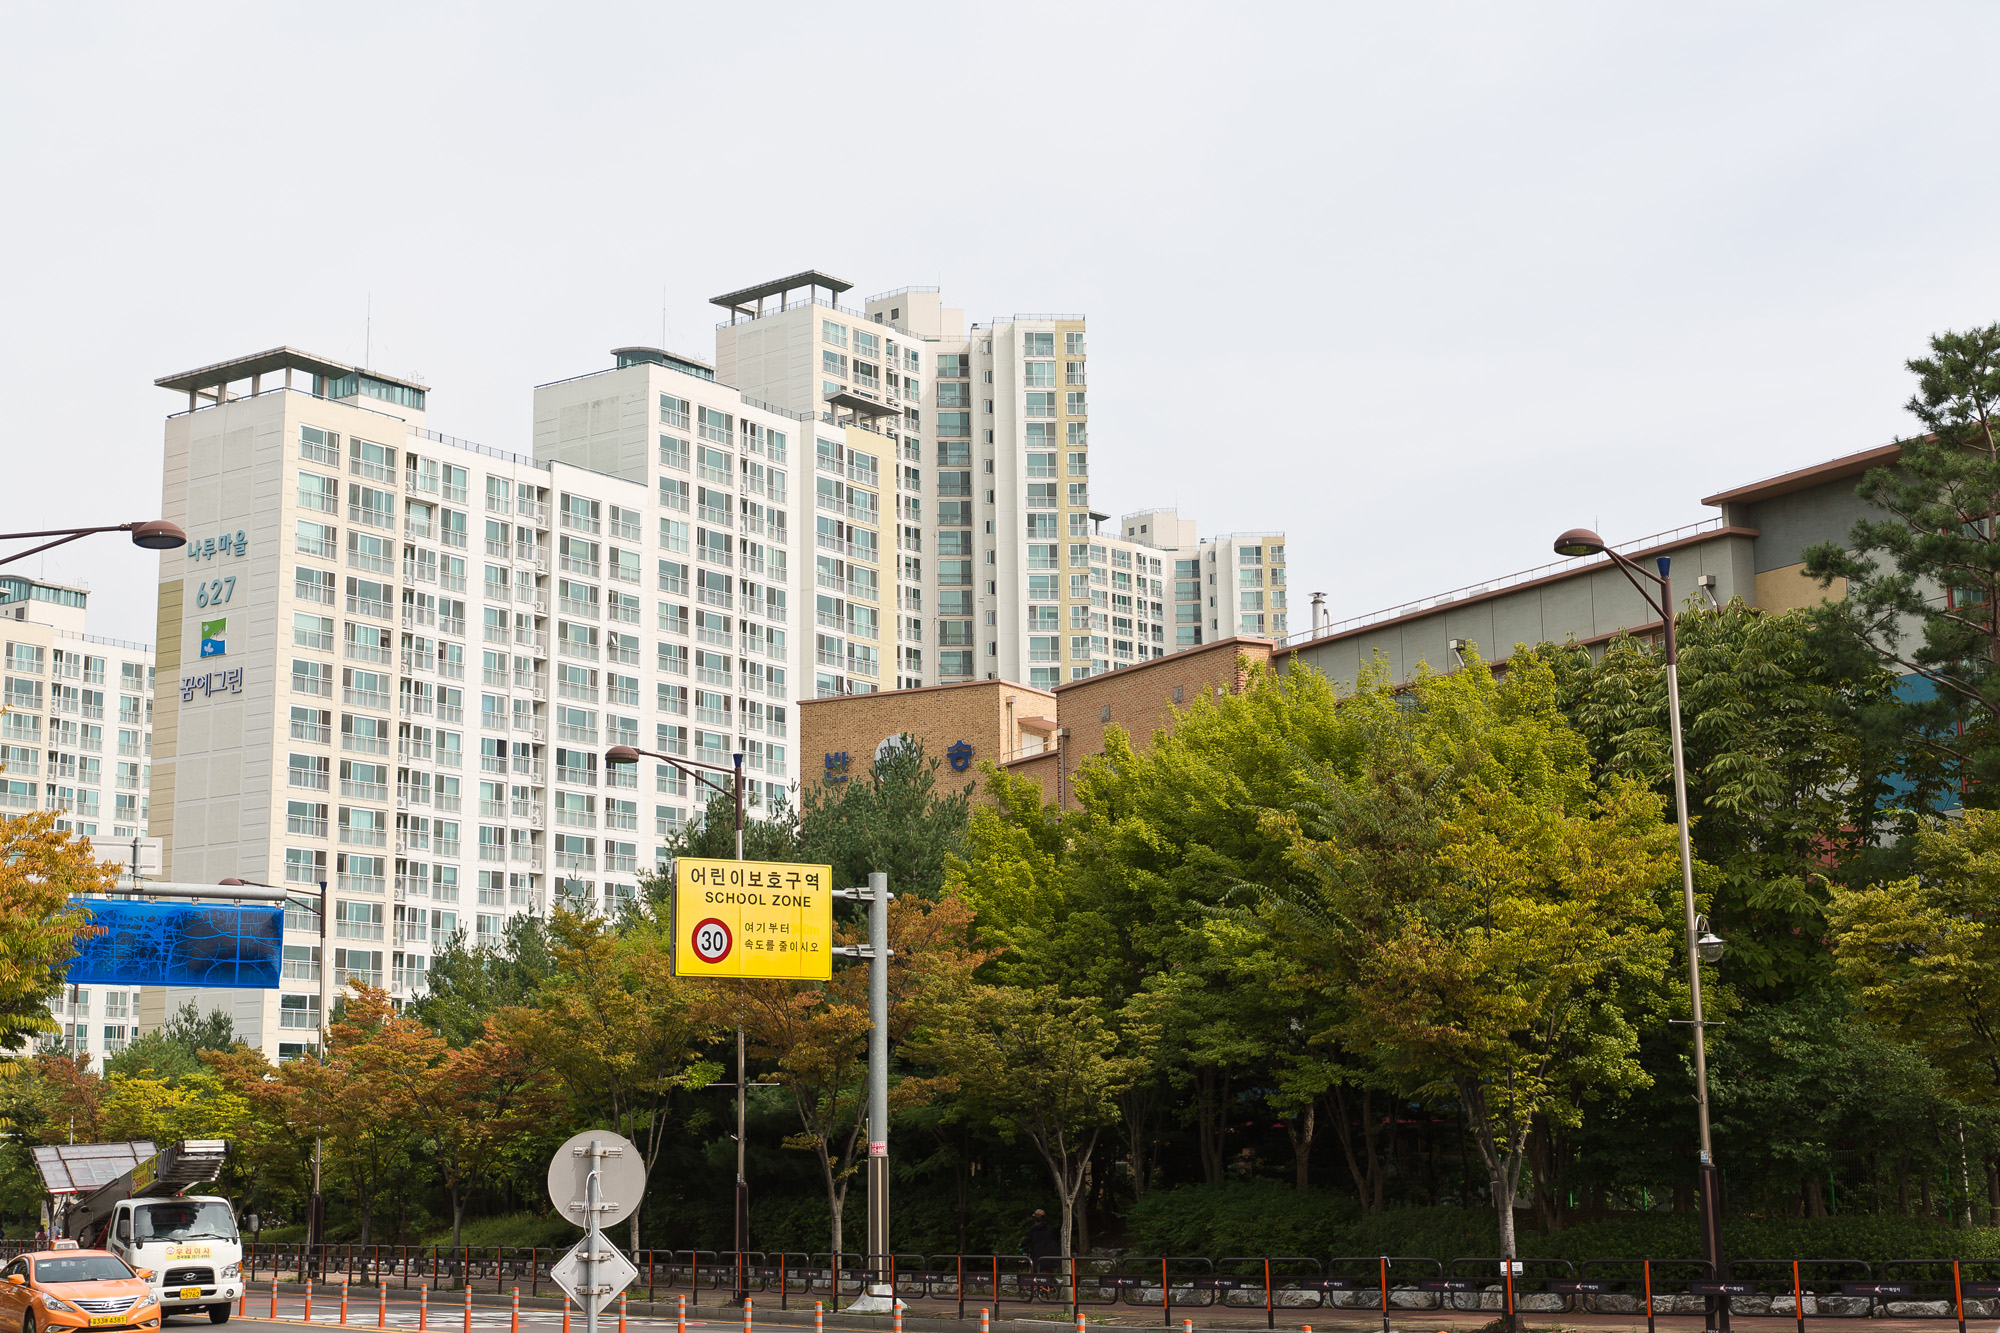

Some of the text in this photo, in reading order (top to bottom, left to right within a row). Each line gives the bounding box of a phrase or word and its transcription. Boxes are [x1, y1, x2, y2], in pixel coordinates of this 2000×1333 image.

[187, 529, 249, 561] 나루마을
[196, 575, 237, 608] 627
[179, 666, 244, 702] 꿈에그린
[946, 739, 975, 771] 송
[691, 867, 820, 891] 어린이보호구역
[705, 891, 812, 908] SCHOOL ZONE
[744, 921, 790, 935] 여기부터
[701, 930, 724, 952] 30
[744, 938, 820, 953] 속도를 줄이시오
[176, 1247, 210, 1255] 우리이사
